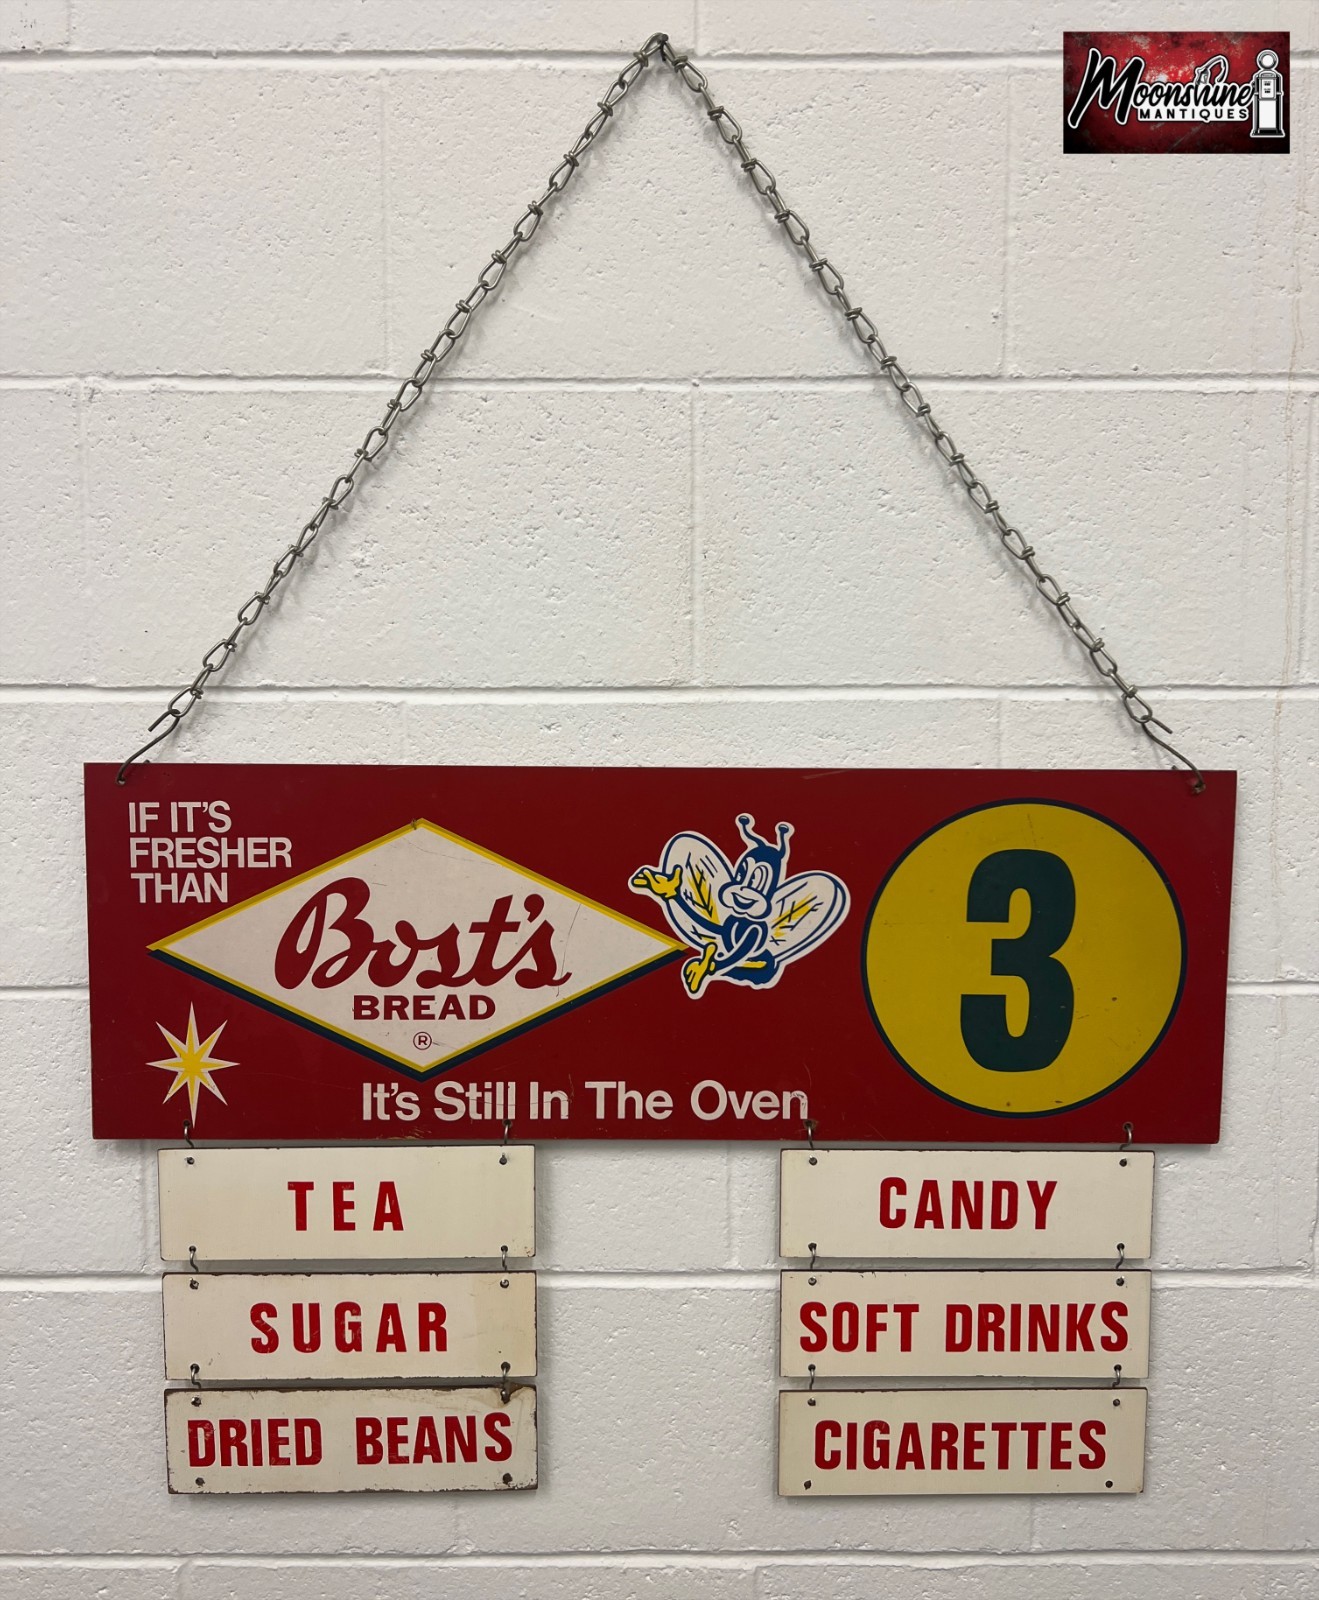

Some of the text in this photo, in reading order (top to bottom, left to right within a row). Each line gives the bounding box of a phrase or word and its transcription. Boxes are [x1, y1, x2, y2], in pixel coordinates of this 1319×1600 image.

[128, 800, 232, 833] IF IT'S
[129, 836, 292, 869] FRESHER
[130, 872, 228, 903] THAN
[274, 877, 571, 990] Bost's
[960, 848, 1076, 1073] 3
[353, 994, 497, 1020] BREAD
[361, 1079, 809, 1121] It's Still In The Oven
[287, 1181, 404, 1231] TEA
[879, 1176, 1058, 1230] CANDY
[250, 1301, 448, 1354] SUGAR
[799, 1301, 1129, 1353] SOFT DRINKS
[187, 1412, 513, 1467] DRIED BEANS
[814, 1419, 1107, 1470] CIGARETTES
